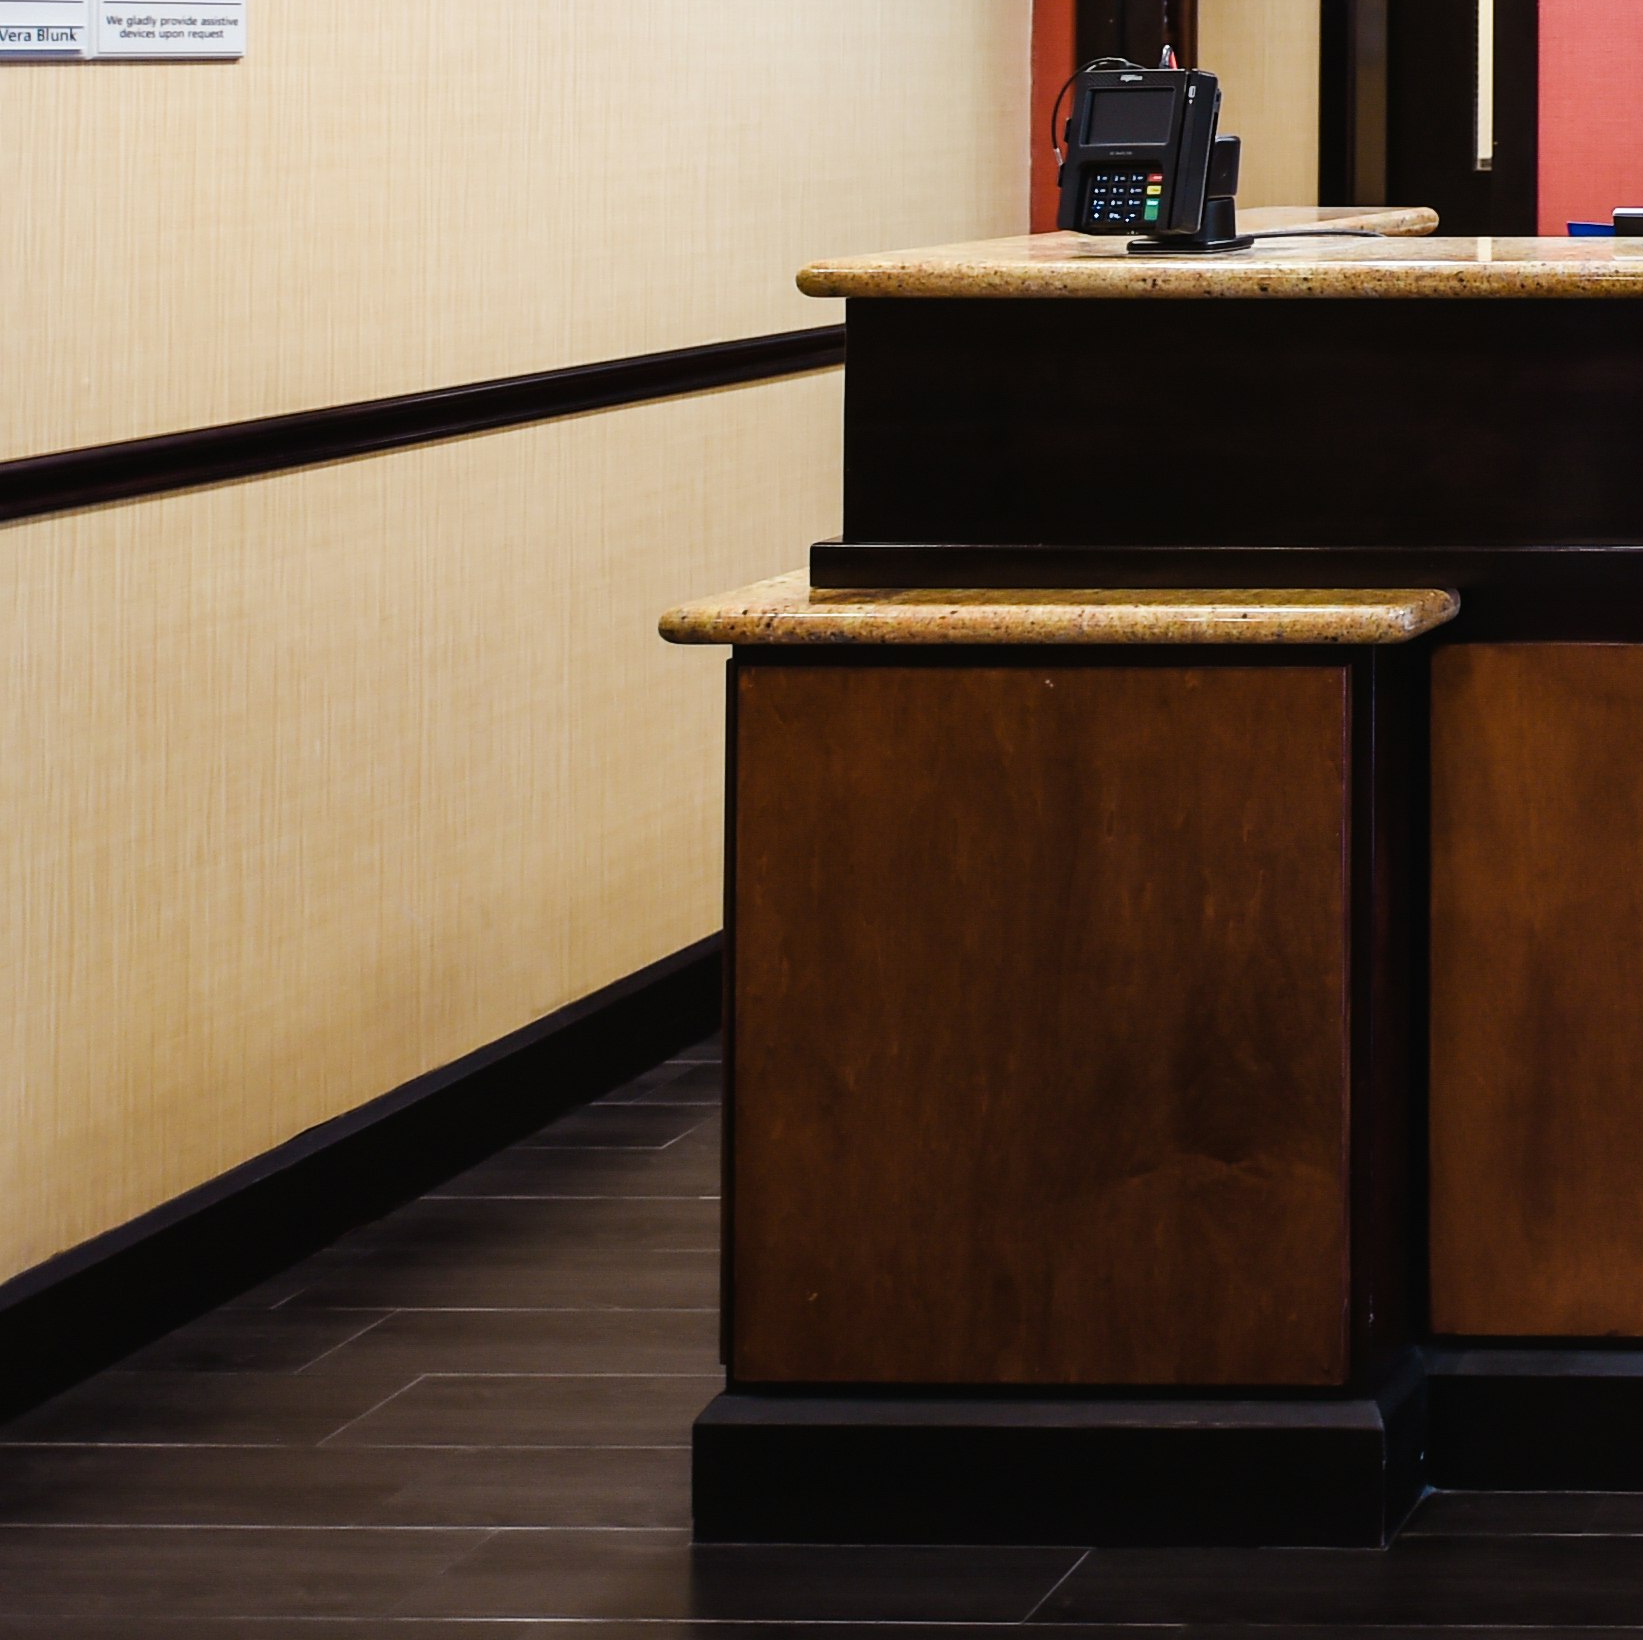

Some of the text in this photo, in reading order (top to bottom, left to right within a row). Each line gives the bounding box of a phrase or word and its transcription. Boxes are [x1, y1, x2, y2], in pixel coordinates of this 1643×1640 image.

[106, 15, 239, 28] We gladly provide assistive
[0, 27, 77, 42] Vera Blunk
[120, 29, 224, 40] devices upon request
